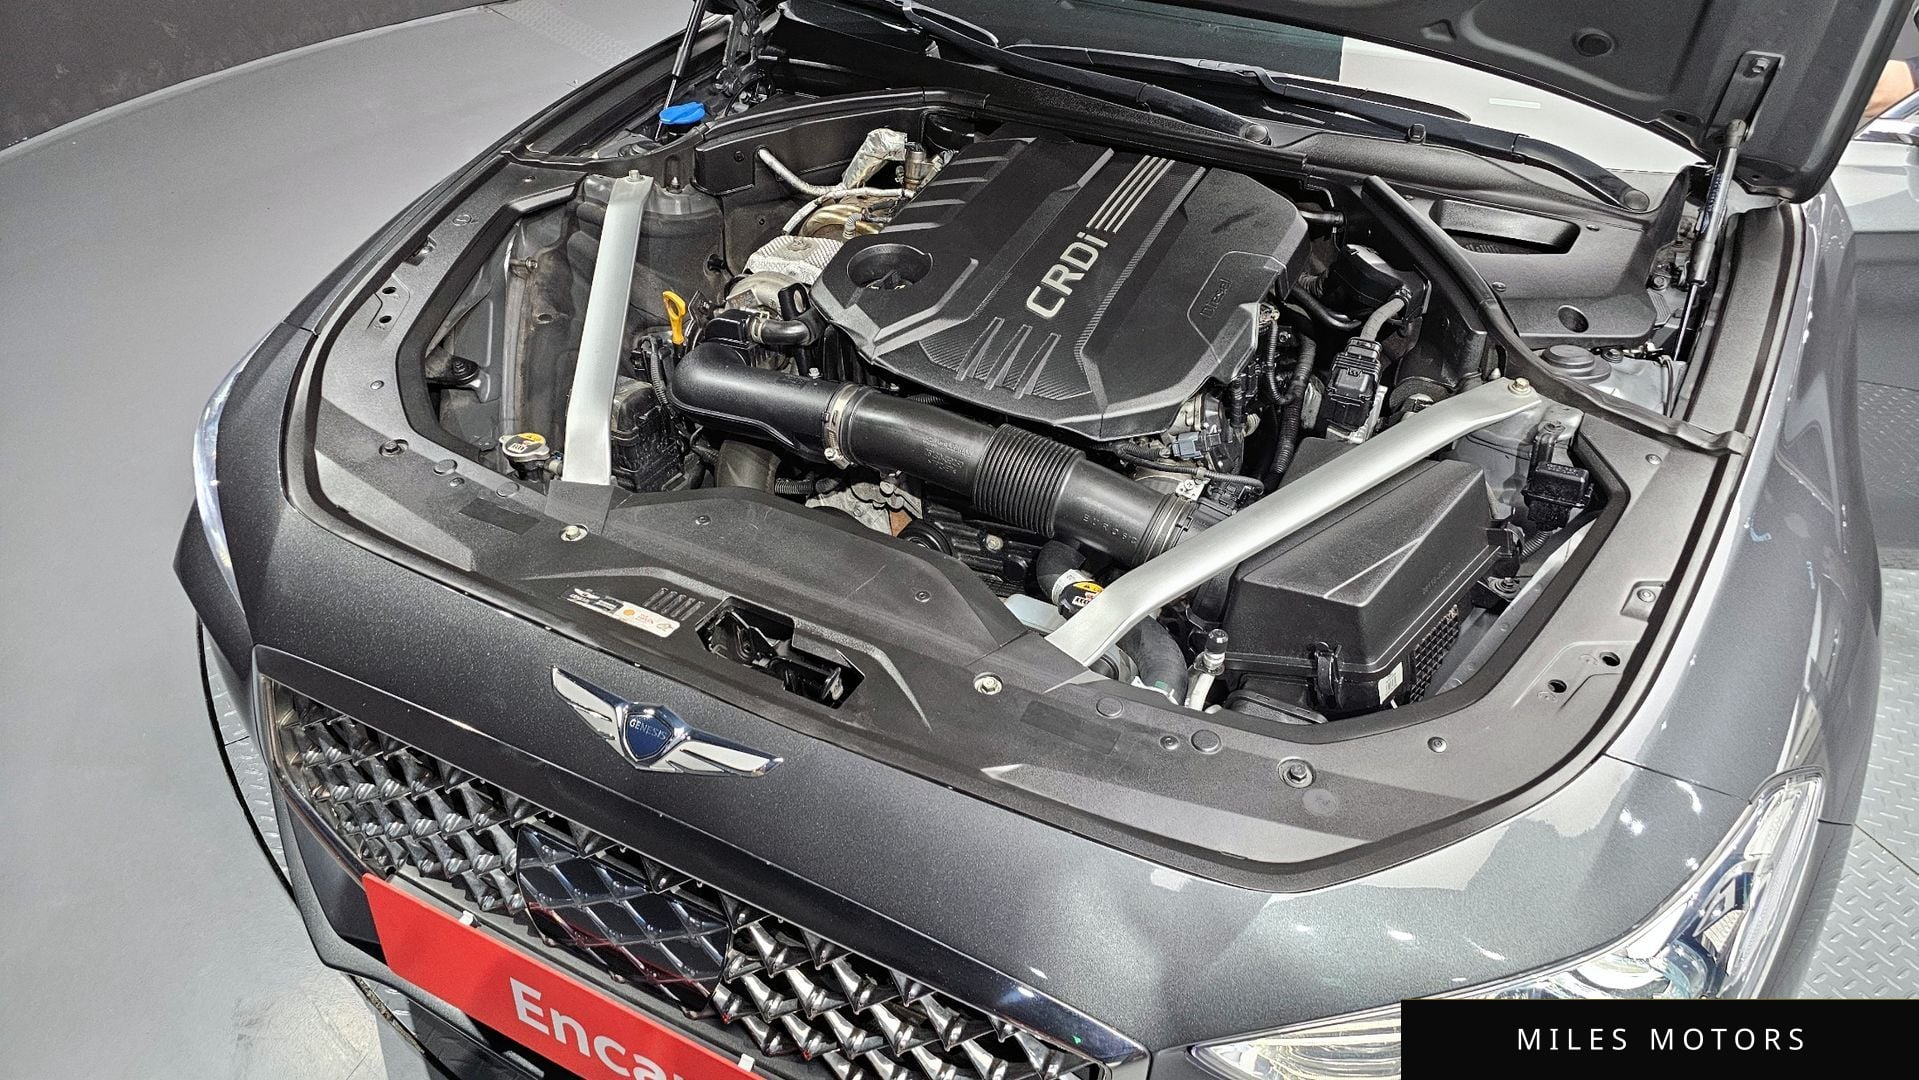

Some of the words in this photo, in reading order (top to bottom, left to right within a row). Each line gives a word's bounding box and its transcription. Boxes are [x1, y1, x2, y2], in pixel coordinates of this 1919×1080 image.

[1026, 231, 1109, 319] CRDi
[629, 718, 668, 740] GENESIS
[509, 976, 686, 1080] Enca
